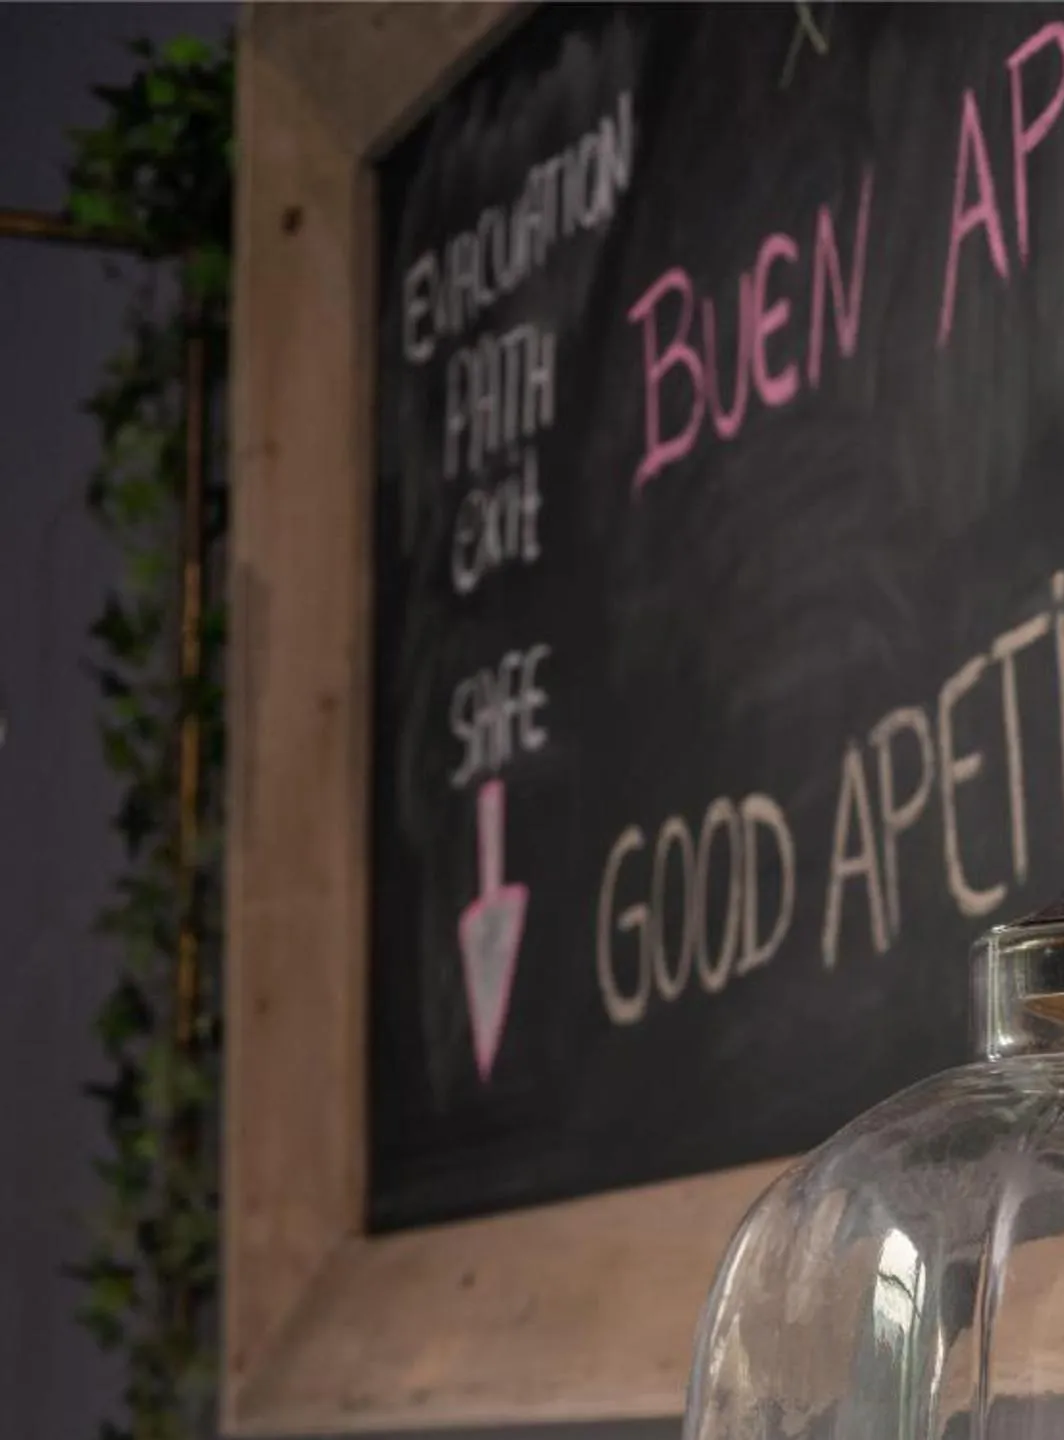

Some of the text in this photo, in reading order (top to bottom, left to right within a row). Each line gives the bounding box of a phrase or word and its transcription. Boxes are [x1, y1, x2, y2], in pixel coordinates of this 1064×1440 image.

[404, 91, 634, 363] EVACUATION
[628, 165, 873, 494] BUEN
[444, 323, 555, 480] PATH
[448, 644, 551, 788] SAFE
[597, 793, 797, 1025] GOOD
